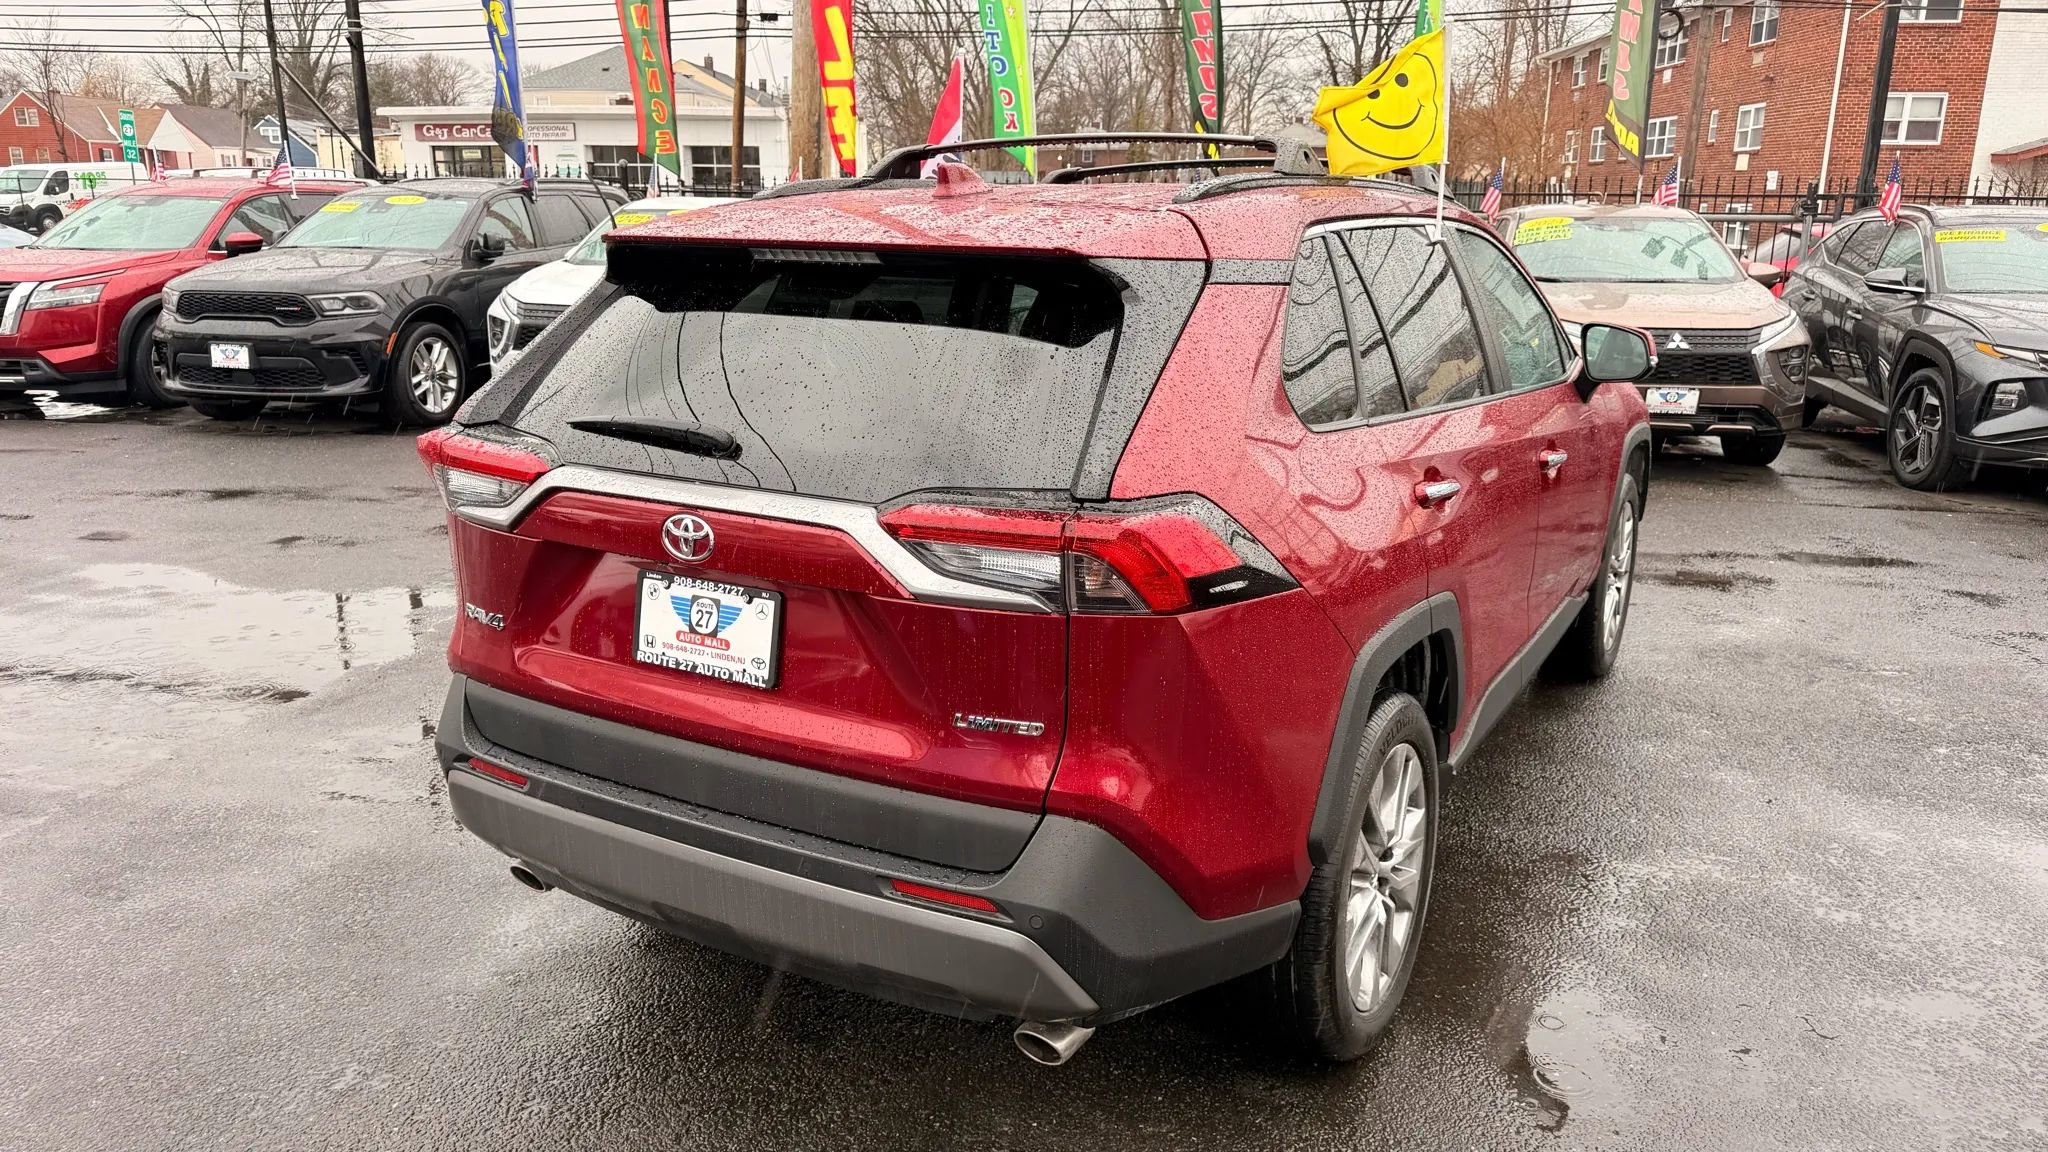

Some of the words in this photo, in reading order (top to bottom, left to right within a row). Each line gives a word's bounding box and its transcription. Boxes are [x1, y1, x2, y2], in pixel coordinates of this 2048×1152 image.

[124, 126, 132, 134] 27
[452, 125, 493, 138] CarCa
[127, 149, 137, 158] 32
[673, 575, 745, 597] 908-648-2727
[761, 591, 771, 599] NJ
[696, 601, 714, 610] ROUTE
[465, 602, 505, 631] RAV4
[695, 609, 713, 629] 27
[661, 641, 706, 657] 908-648-2727
[679, 632, 702, 645] AUTO
[704, 636, 727, 649] MALL
[636, 650, 677, 669] ROUTE
[679, 660, 695, 672] 27
[695, 663, 731, 679] AUTO
[732, 671, 768, 688] MALL
[952, 713, 1045, 737] LIMITED
